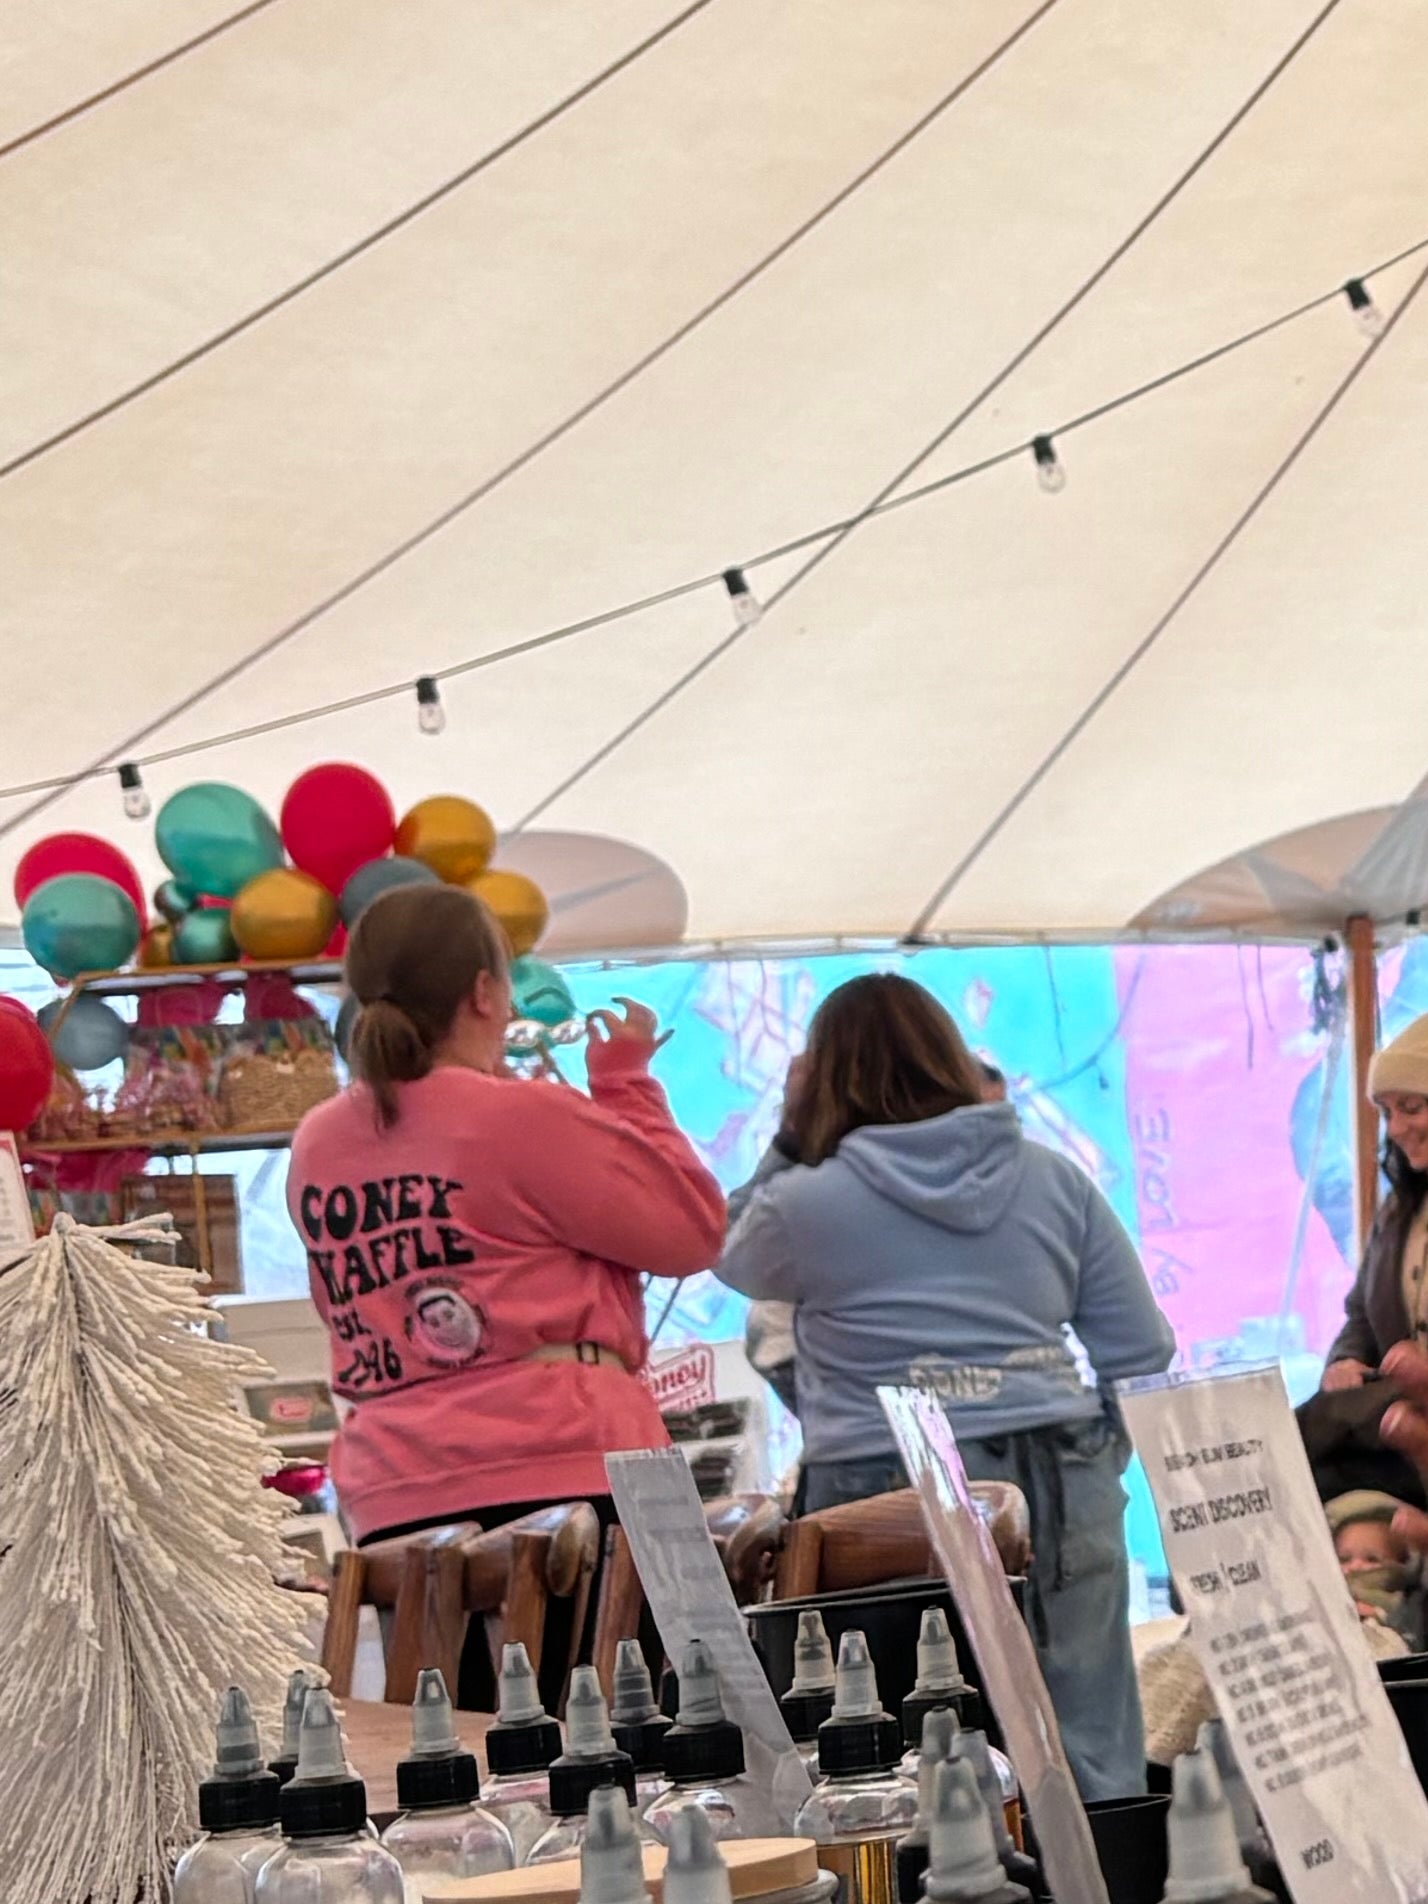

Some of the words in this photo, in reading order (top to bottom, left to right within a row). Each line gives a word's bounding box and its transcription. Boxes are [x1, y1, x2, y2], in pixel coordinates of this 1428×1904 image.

[301, 1173, 463, 1243] CONEY
[1169, 1502, 1209, 1534] SCENT
[1208, 1486, 1273, 1524] DISCOVERY
[1228, 1559, 1262, 1586] CLEAN
[1301, 1839, 1335, 1870] WOOD
